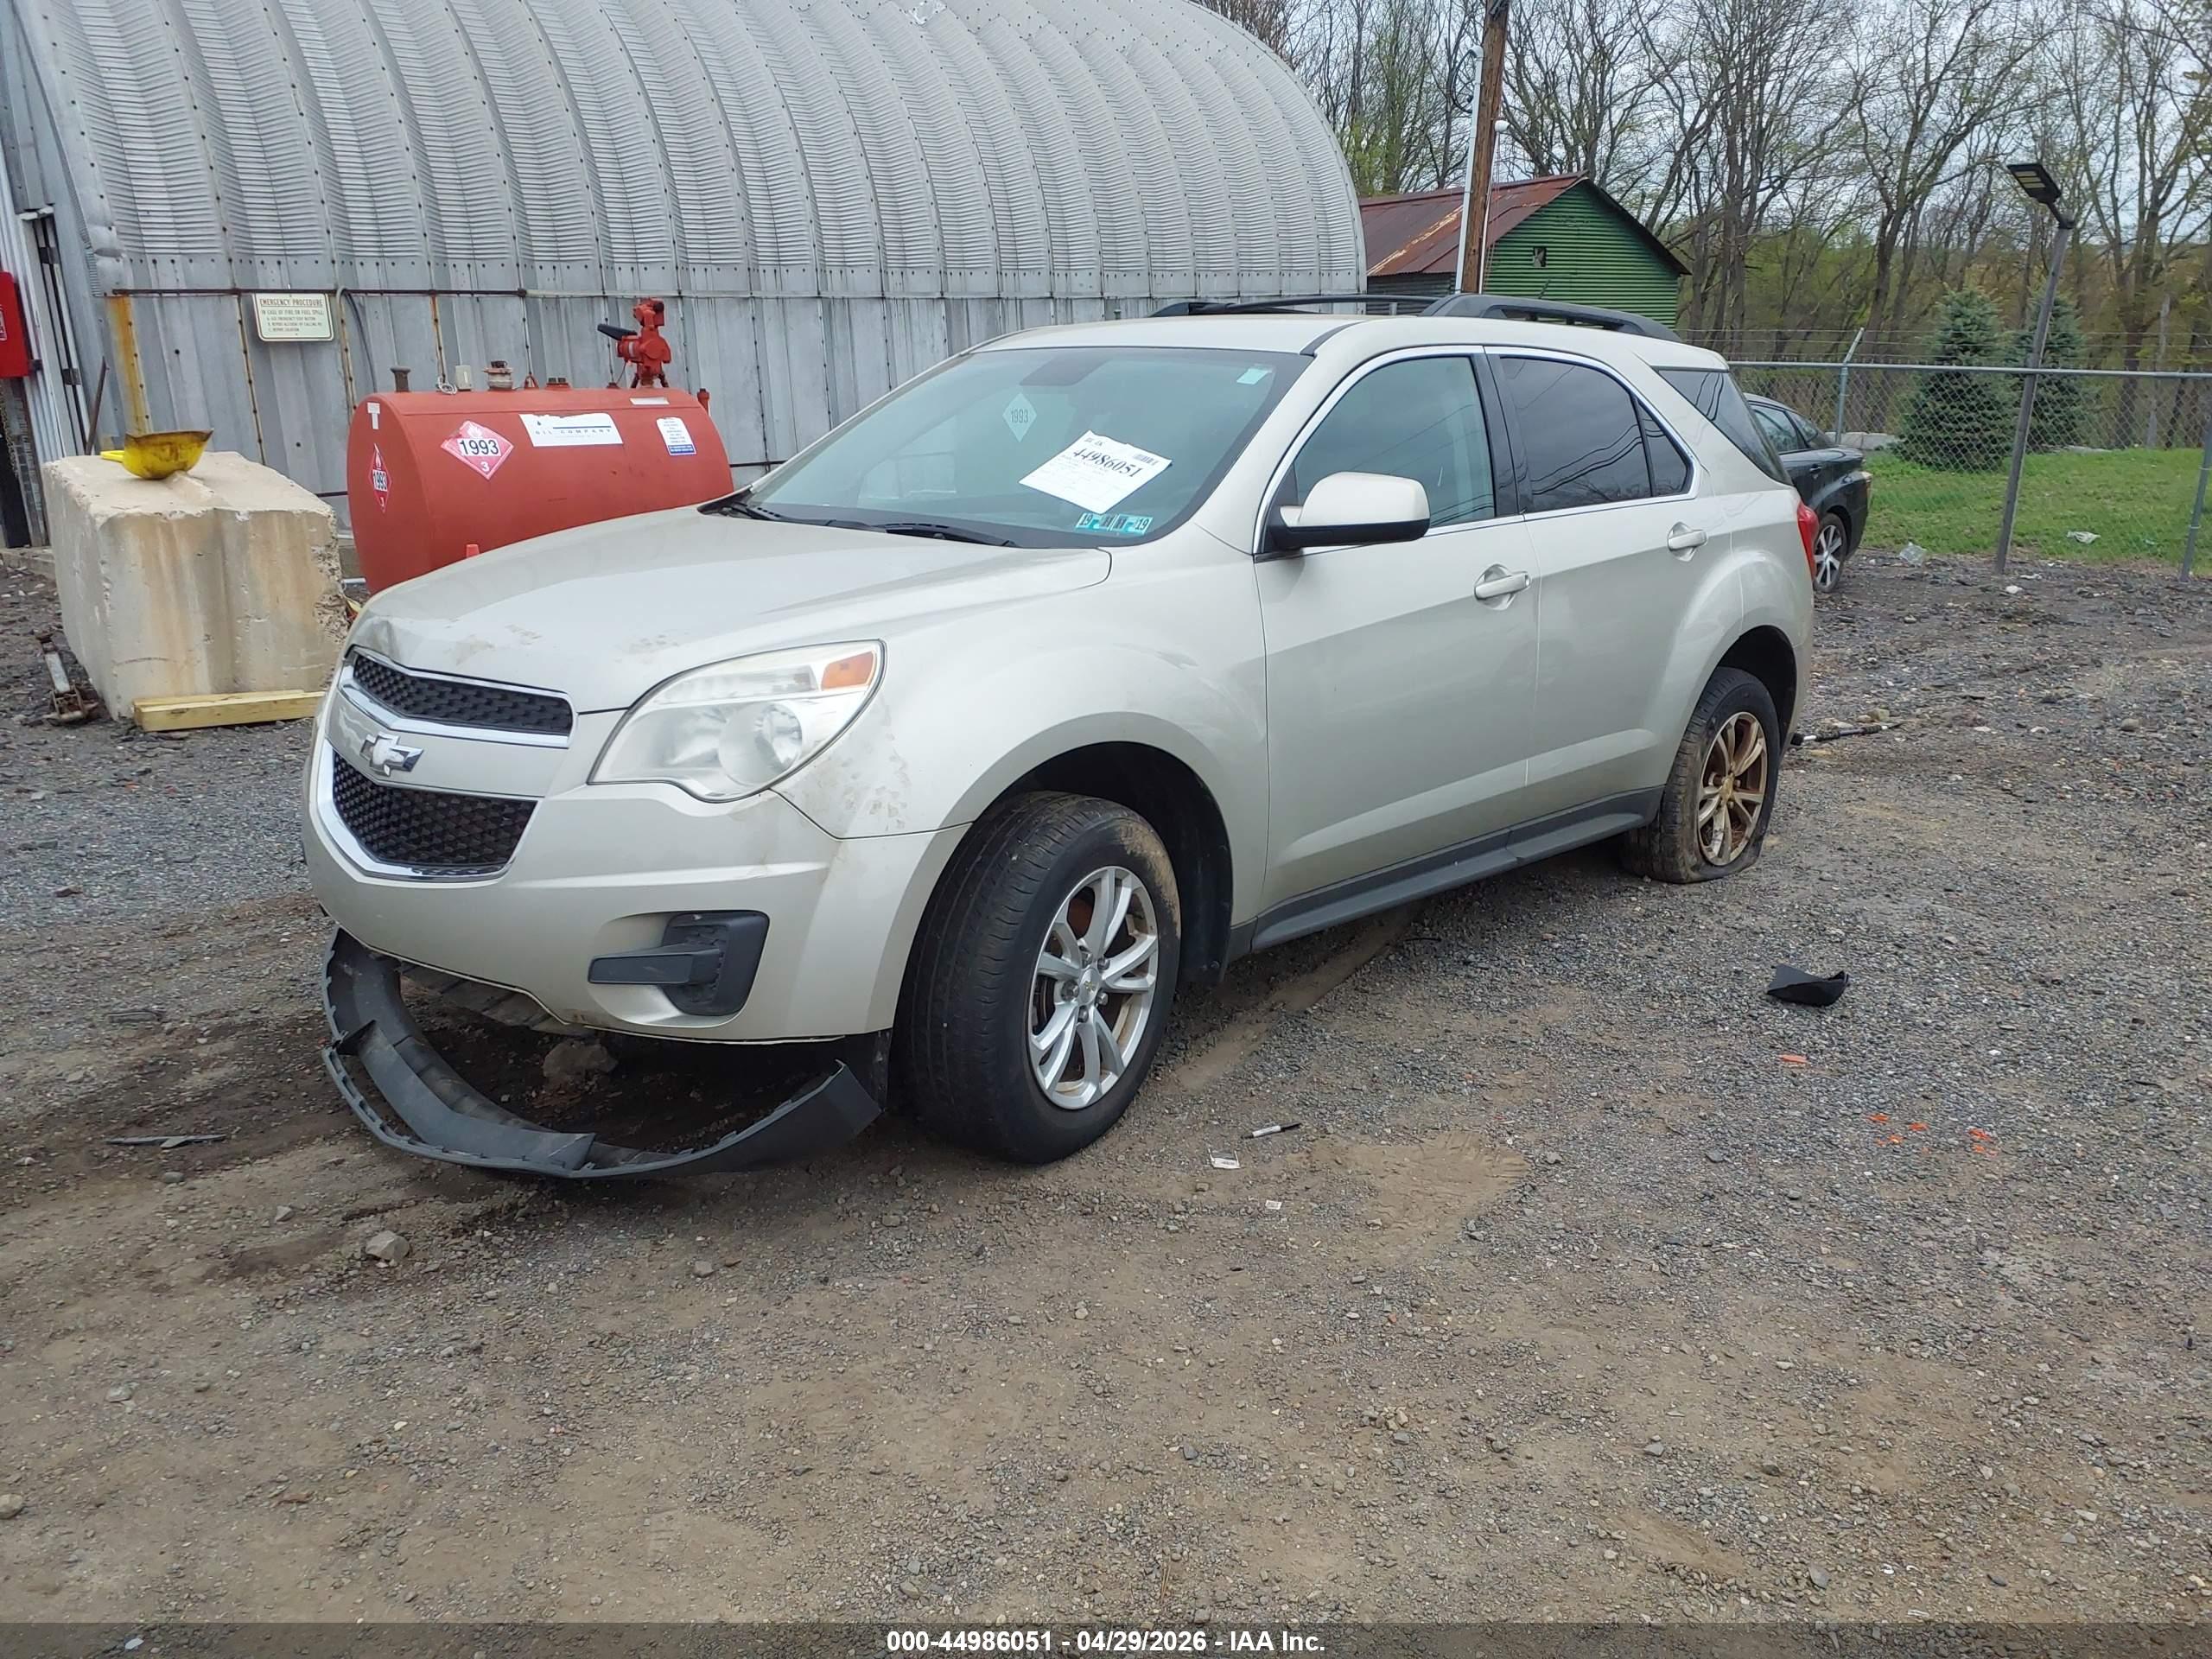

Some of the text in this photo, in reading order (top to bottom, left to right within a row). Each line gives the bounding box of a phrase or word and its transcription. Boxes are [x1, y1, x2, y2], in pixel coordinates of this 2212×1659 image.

[460, 439, 499, 454] 1993
[480, 461, 490, 472] 3
[1073, 448, 1142, 477] 44986051
[372, 471, 387, 490] 1993
[1135, 518, 1149, 531] 19
